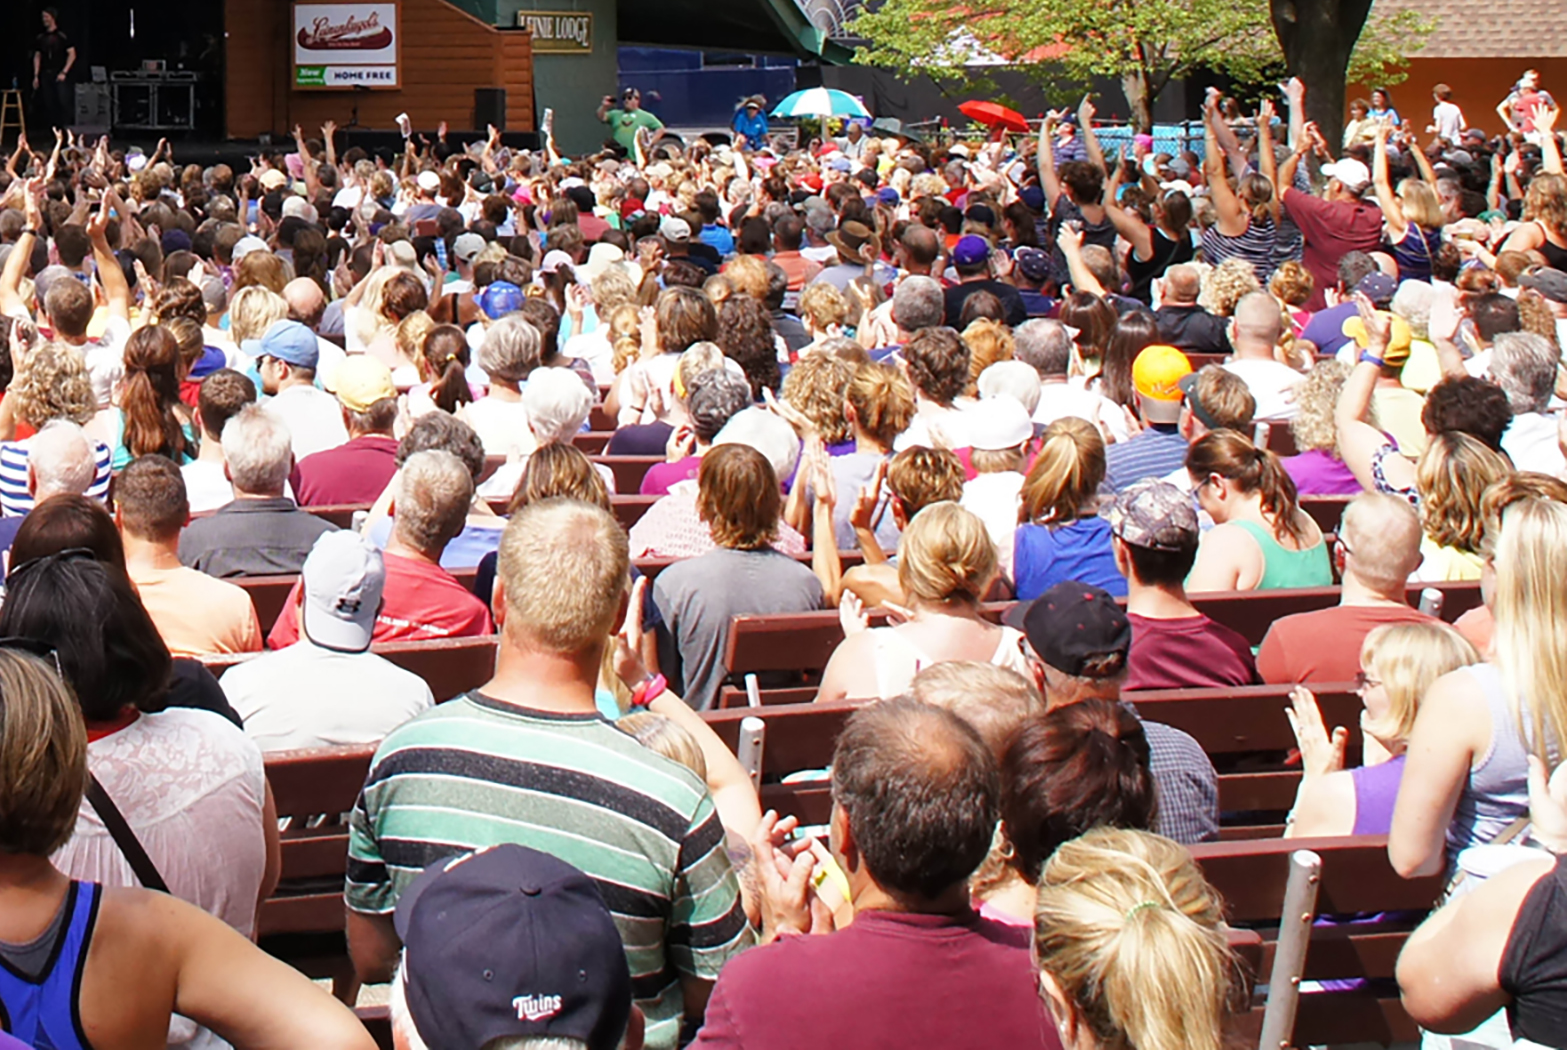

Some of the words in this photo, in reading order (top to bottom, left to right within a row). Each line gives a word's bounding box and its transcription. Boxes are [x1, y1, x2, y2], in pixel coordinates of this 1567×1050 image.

[555, 16, 589, 47] LODGE
[334, 71, 363, 80] HOME
[366, 71, 392, 80] FREE
[512, 993, 562, 1022] Twins
